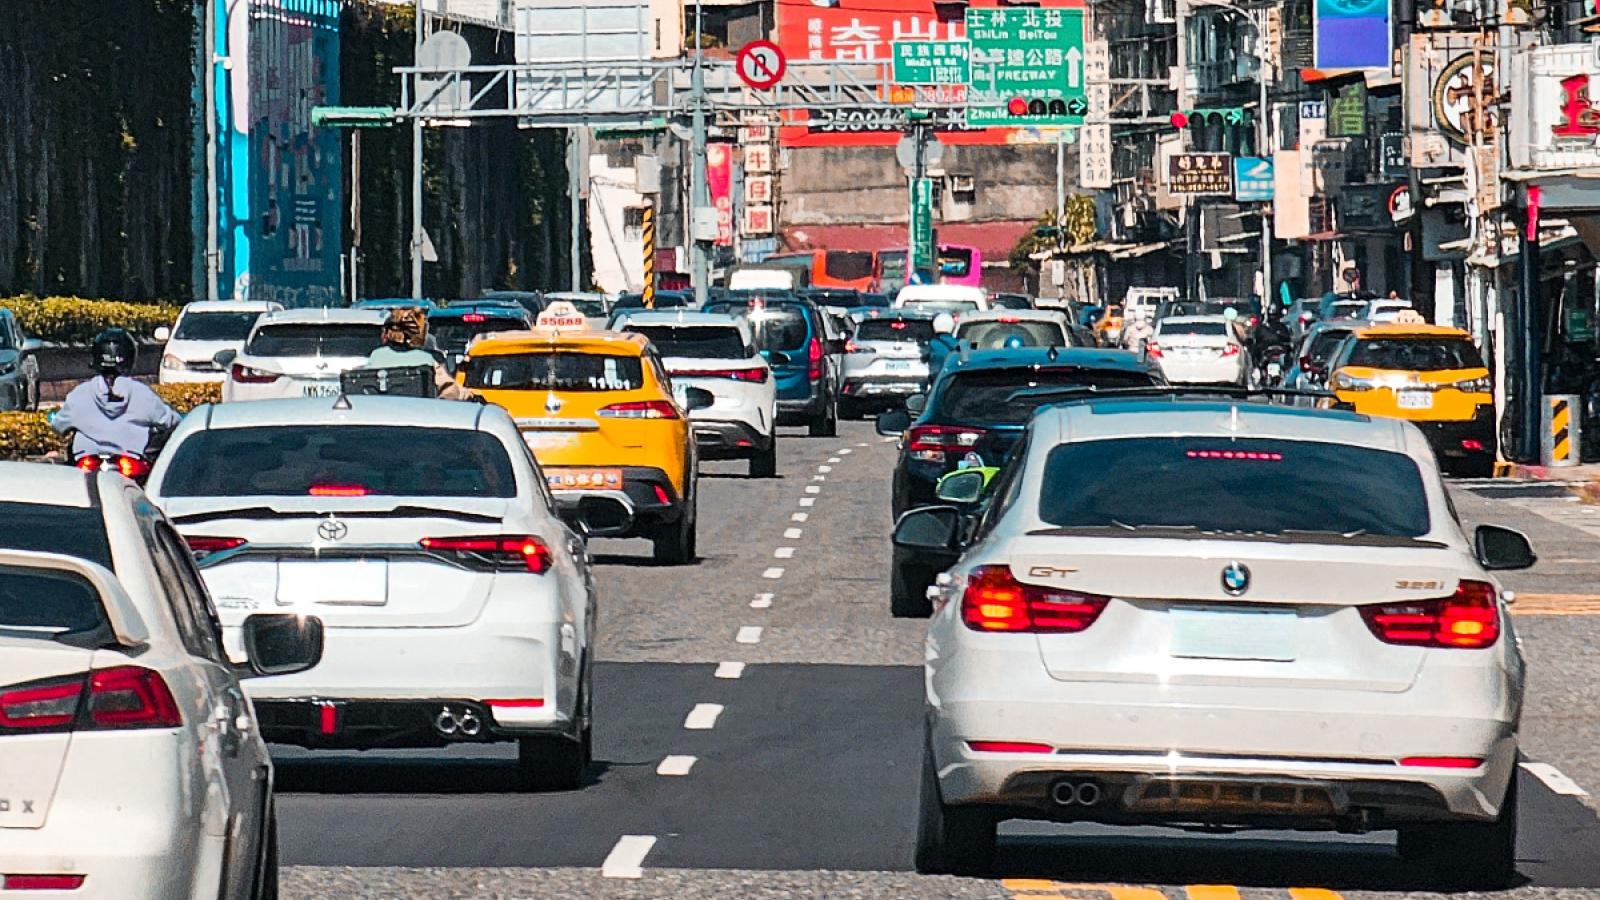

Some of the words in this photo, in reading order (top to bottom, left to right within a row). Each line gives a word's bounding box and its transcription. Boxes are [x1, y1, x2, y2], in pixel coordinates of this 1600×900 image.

[974, 29, 1008, 39] ShiLin
[1018, 29, 1057, 39] BeiTou
[997, 70, 1056, 81] FREEWAY
[1028, 566, 1079, 578] GT
